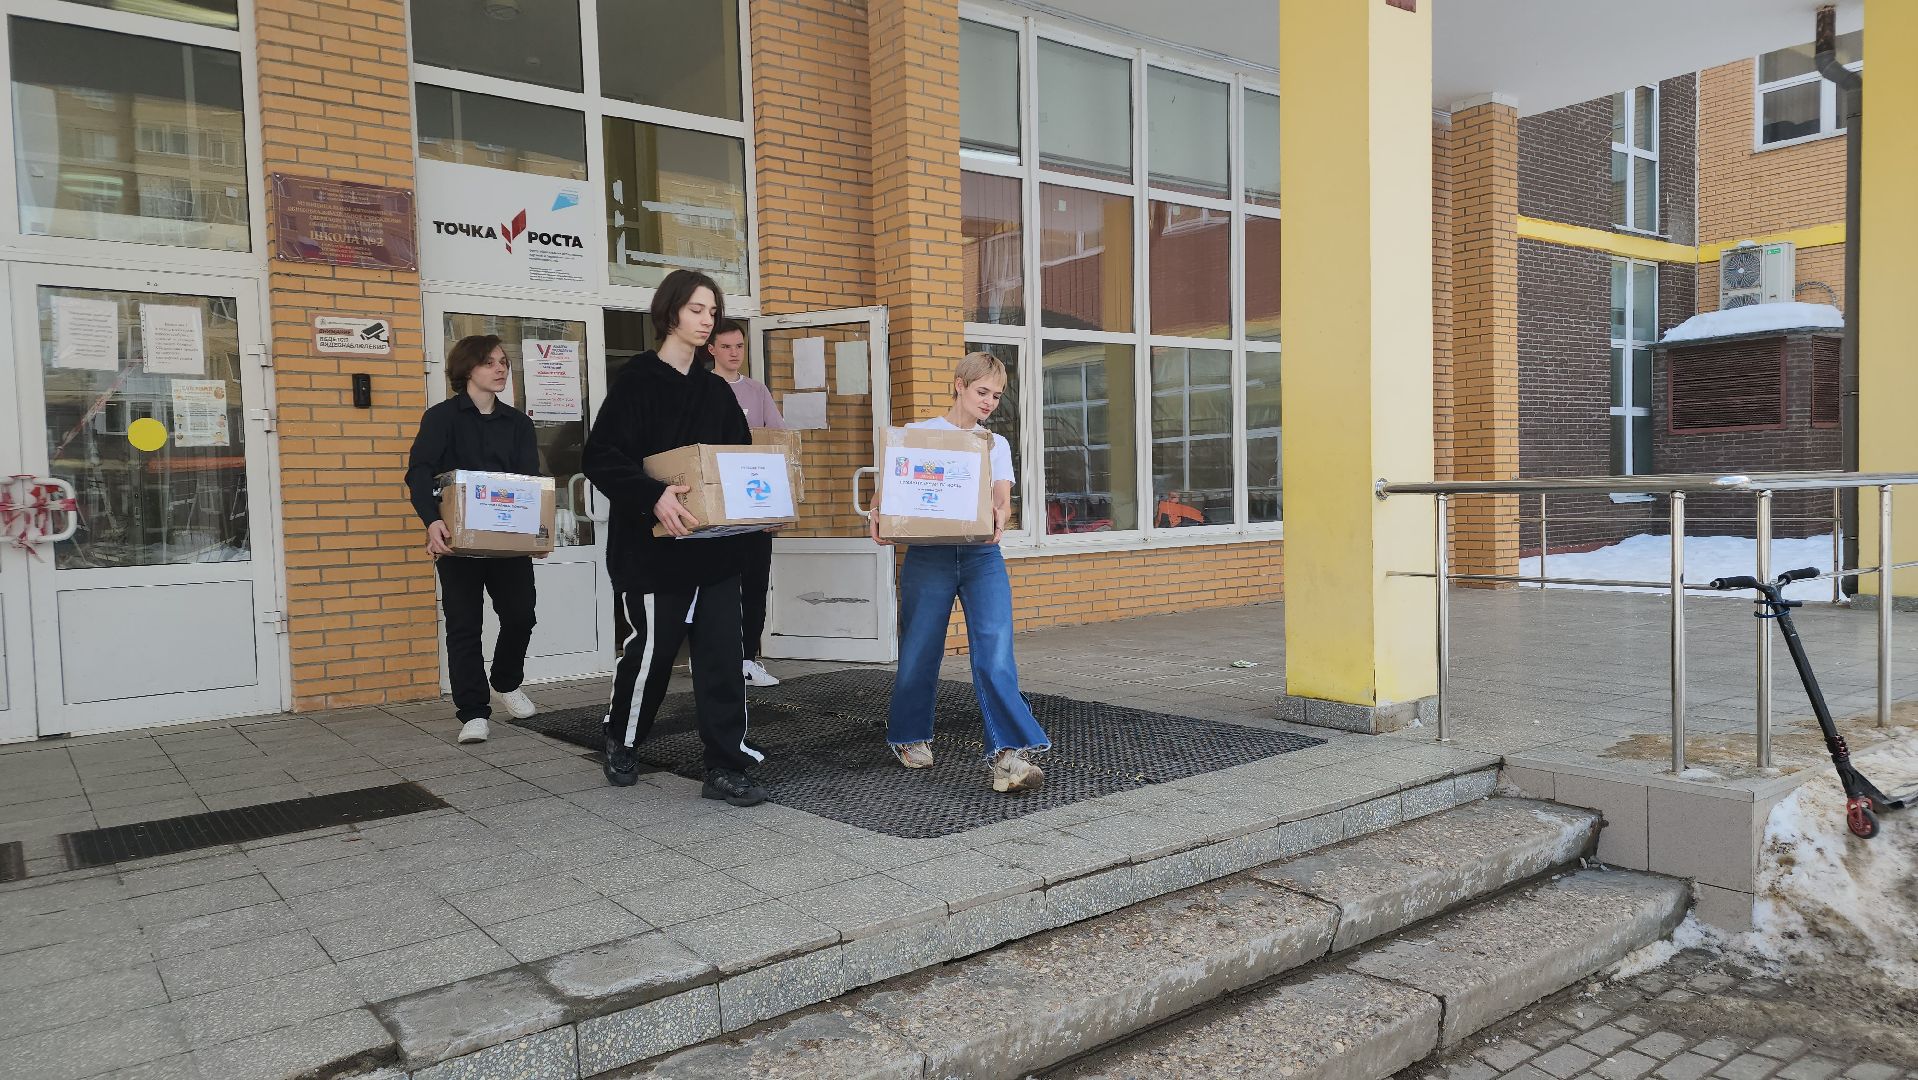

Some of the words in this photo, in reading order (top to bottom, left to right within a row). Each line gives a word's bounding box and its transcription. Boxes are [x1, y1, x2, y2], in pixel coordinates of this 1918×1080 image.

[310, 230, 360, 245] ШКОЛА
[362, 238, 384, 247] №2
[433, 220, 497, 239] ТОЧКА
[528, 231, 583, 248] РОСТА
